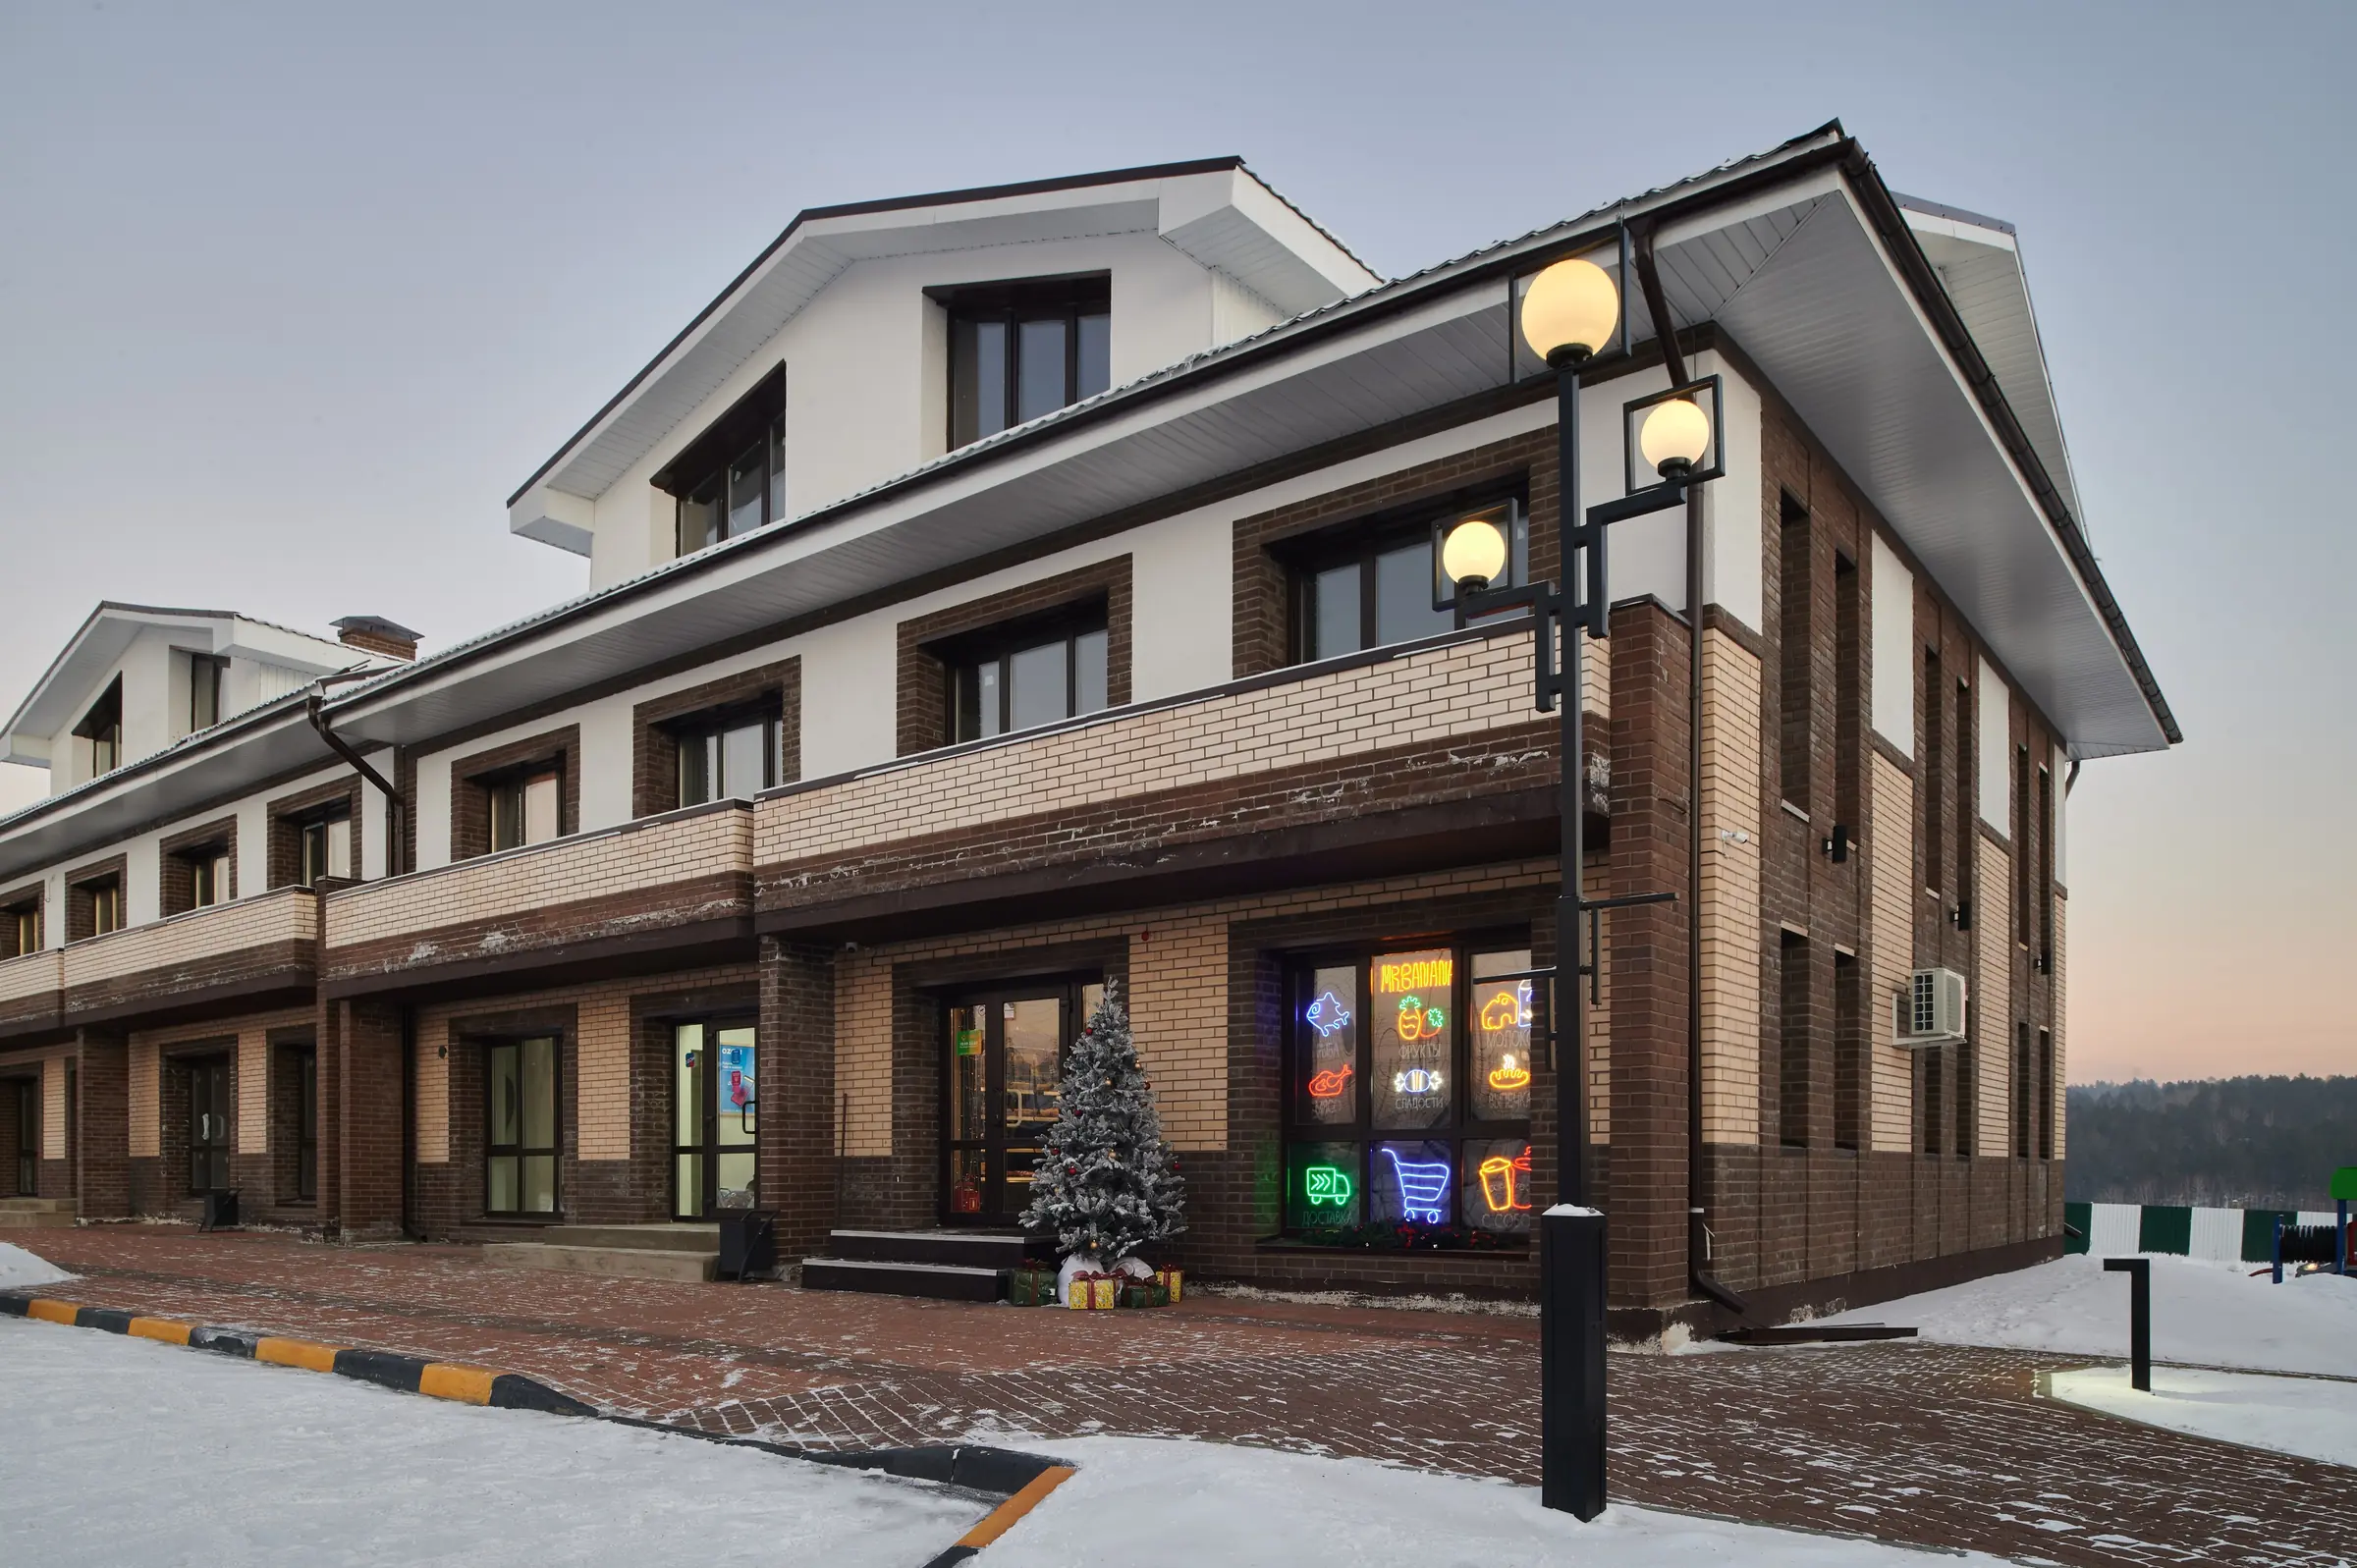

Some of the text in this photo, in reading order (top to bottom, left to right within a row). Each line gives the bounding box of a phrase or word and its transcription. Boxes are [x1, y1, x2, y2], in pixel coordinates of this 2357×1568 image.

[1398, 1043, 1442, 1059] ФРУКТЫ
[1396, 1097, 1444, 1110] СЛАДОСТИ
[1302, 1210, 1352, 1227] ДОСТАВКА
